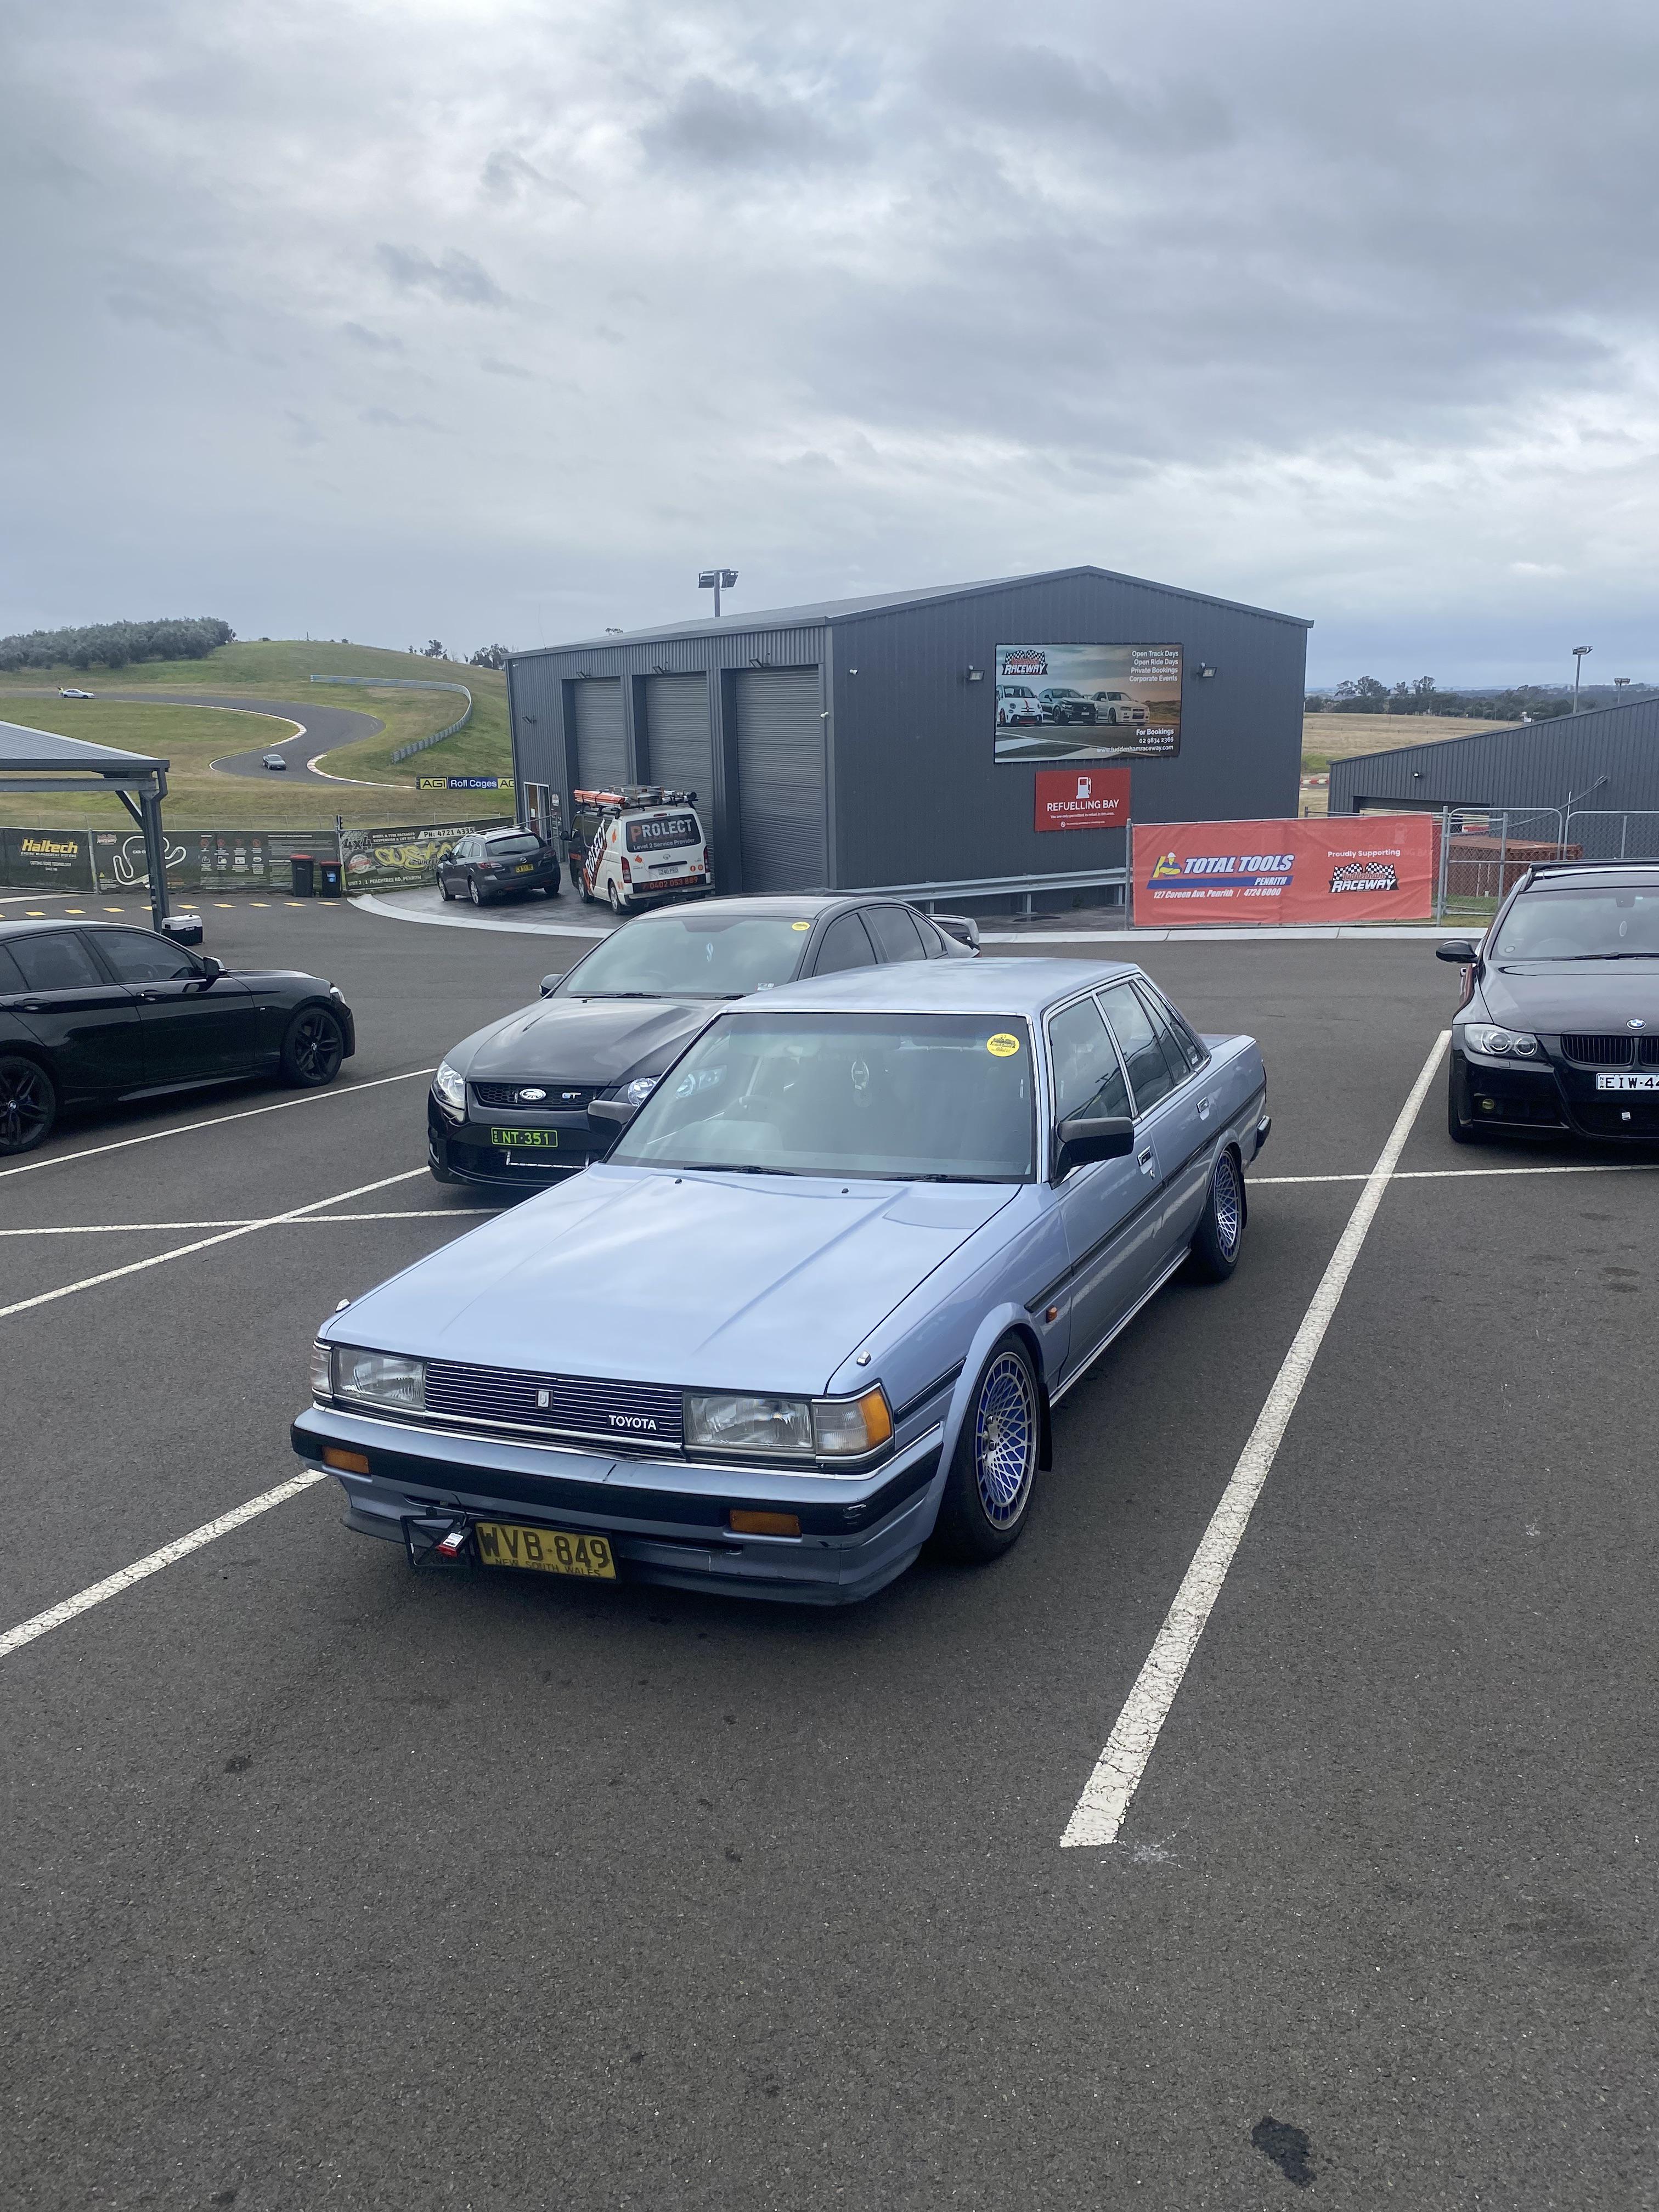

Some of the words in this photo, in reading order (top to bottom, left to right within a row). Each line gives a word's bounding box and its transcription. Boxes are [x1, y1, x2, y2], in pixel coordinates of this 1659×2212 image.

[1132, 650, 1148, 658] Open
[1165, 650, 1179, 658] Days
[1004, 664, 1046, 675] RACEWAY
[422, 780, 445, 788] AGI
[469, 780, 497, 789] Cages
[500, 780, 514, 788] AG
[1047, 800, 1101, 812] REFUELLING
[1102, 799, 1120, 809] BAY
[630, 819, 692, 842] PROLECT
[21, 838, 78, 854] Haltech
[674, 838, 695, 846] Provider
[1328, 850, 1357, 859] Proudly
[1358, 849, 1401, 857] Supporting
[1183, 856, 1236, 874] TOTAL
[1238, 854, 1295, 872] TOOLS
[650, 881, 668, 889] 0402
[1254, 877, 1288, 887] PENRITH
[1331, 879, 1396, 893] RACEWAY
[1154, 891, 1165, 899] 127
[1165, 890, 1191, 899] Coreen
[1191, 890, 1206, 898] Ave,
[1206, 889, 1234, 898] Penrith
[1244, 888, 1261, 896] 4724
[1261, 888, 1282, 896] 6000
[608, 1415, 657, 1430] TOYOTA
[495, 1558, 519, 1566] NEW
[526, 1561, 558, 1572] SOUTH
[565, 1566, 600, 1577] WALES
